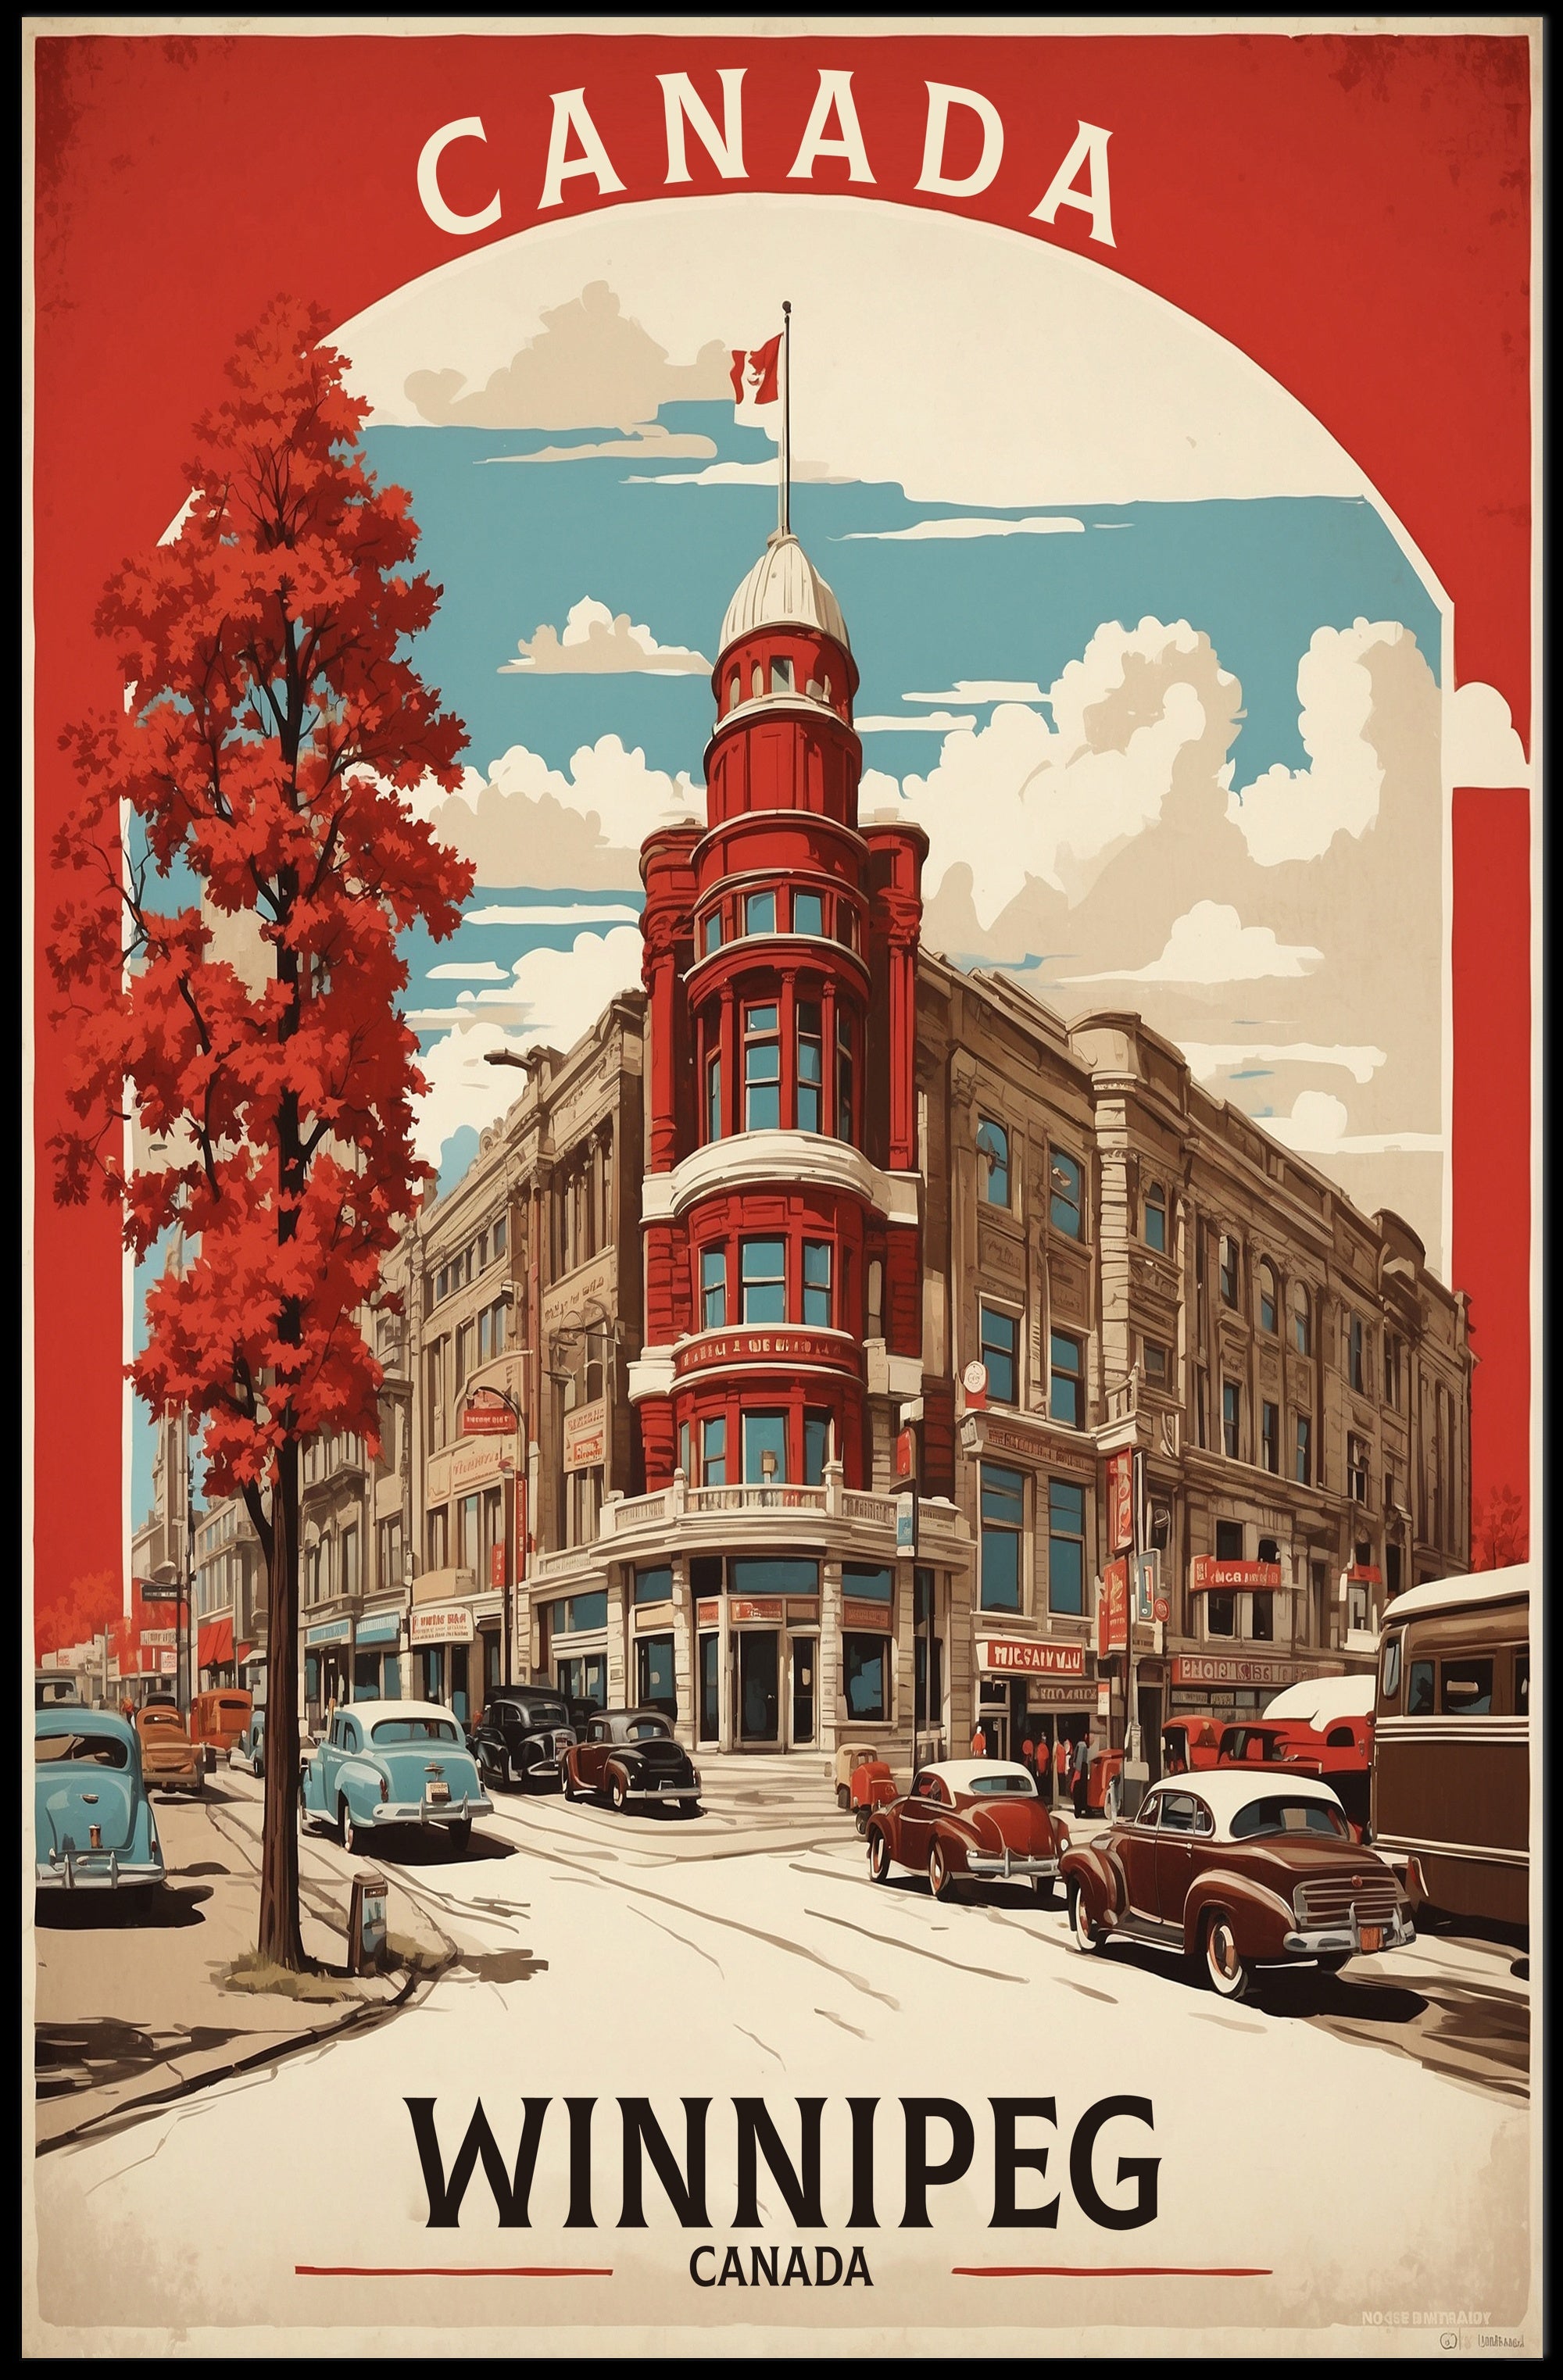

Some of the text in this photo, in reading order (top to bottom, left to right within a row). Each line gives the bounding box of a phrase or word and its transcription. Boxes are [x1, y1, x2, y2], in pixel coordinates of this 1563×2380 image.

[417, 68, 1118, 248] CANADA
[402, 2096, 1162, 2231] WINNIPEG
[689, 2245, 874, 2287] CANADA
